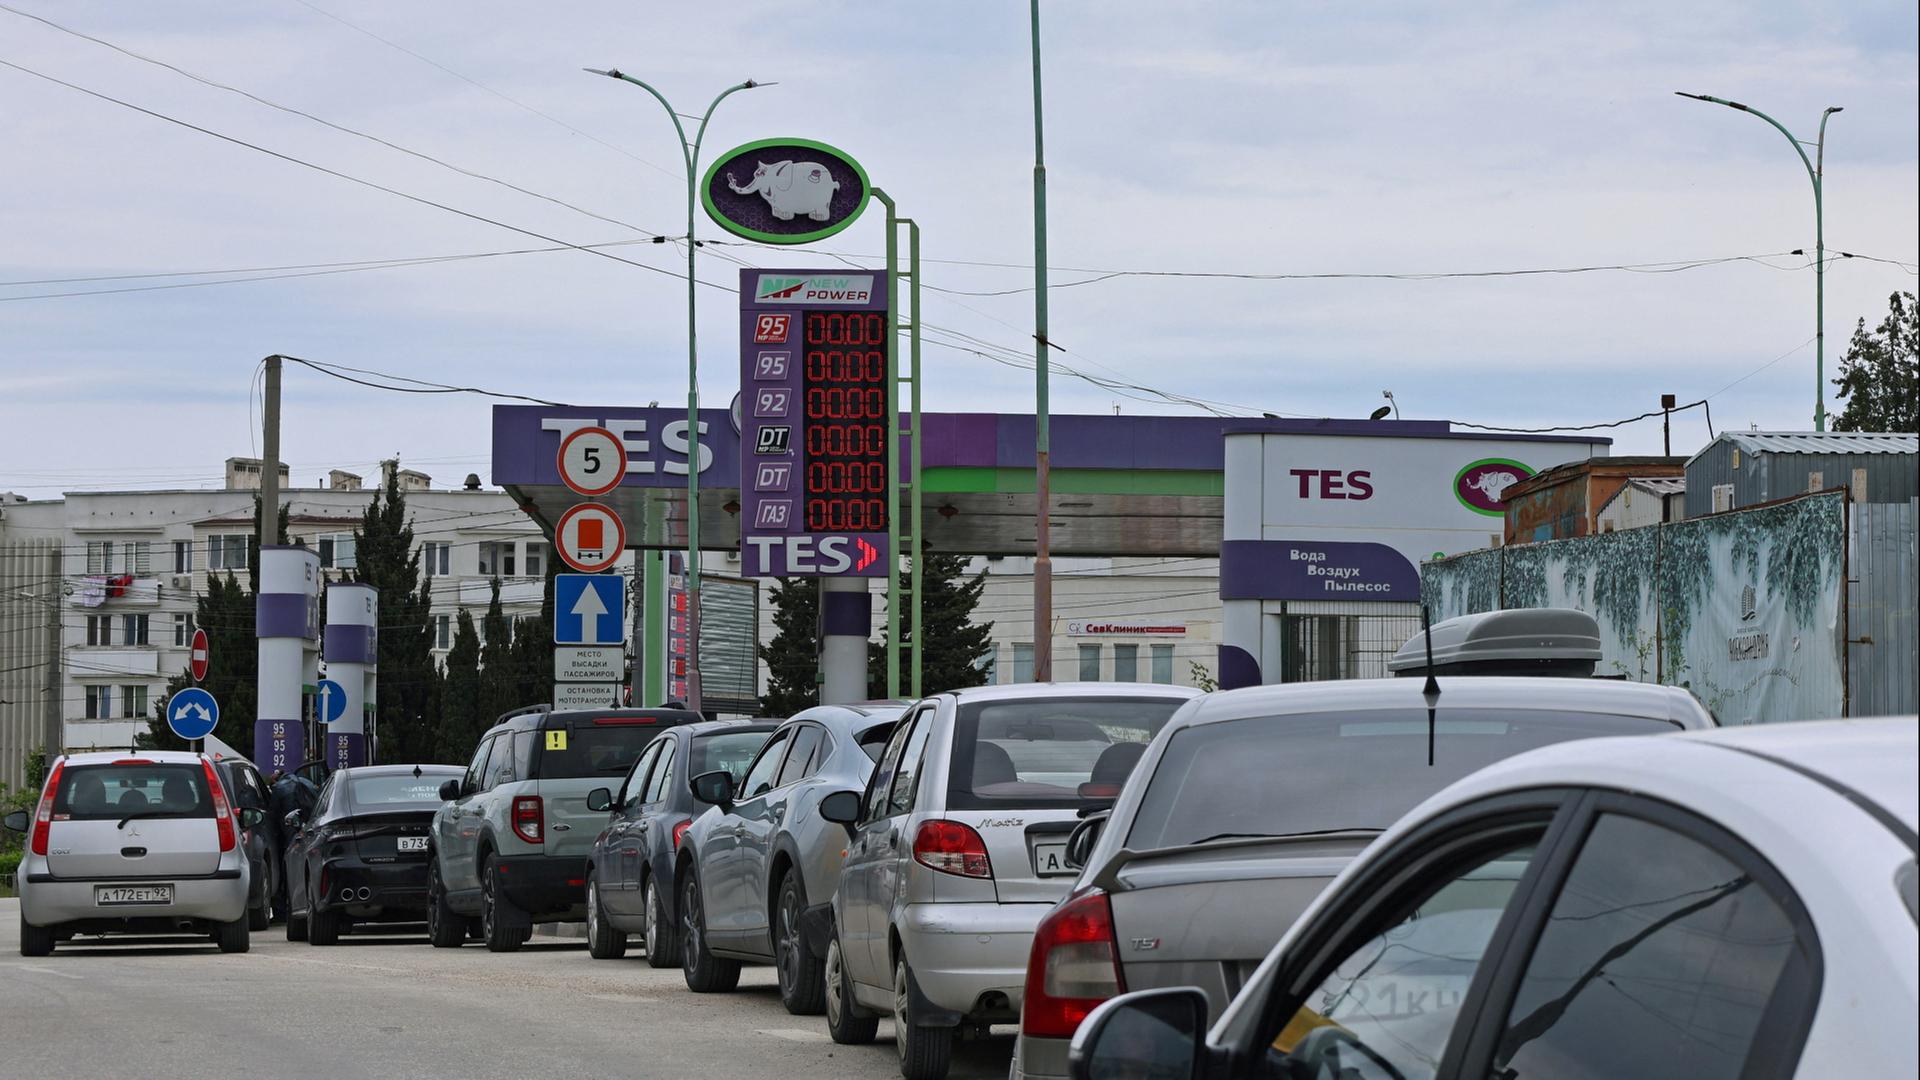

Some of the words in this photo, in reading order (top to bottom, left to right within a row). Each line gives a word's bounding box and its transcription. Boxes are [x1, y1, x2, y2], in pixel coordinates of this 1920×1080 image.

[759, 278, 804, 299] NP
[810, 279, 849, 288] NEW
[806, 290, 868, 300] POWER
[760, 317, 786, 335] 95
[807, 314, 884, 345] 00.00
[760, 356, 786, 375] 95
[807, 351, 884, 382] 00.00
[760, 393, 786, 412] 92
[807, 387, 884, 419] 00.00
[759, 428, 788, 446] DT
[807, 424, 884, 456] 00.00
[583, 447, 601, 474] 5
[759, 468, 788, 487] DT
[808, 461, 884, 493] 00.00
[1290, 469, 1374, 501] TES
[761, 505, 786, 523] ГАЗ
[808, 499, 884, 530] 00.00
[746, 536, 853, 574] TES
[1290, 549, 1326, 562] Вода
[1307, 564, 1360, 579] Воздух
[1325, 580, 1391, 592] Пылесос
[273, 723, 285, 735] 95
[273, 740, 286, 752] 95
[338, 736, 349, 746] 95
[273, 754, 285, 766] 92
[338, 750, 349, 760] 95
